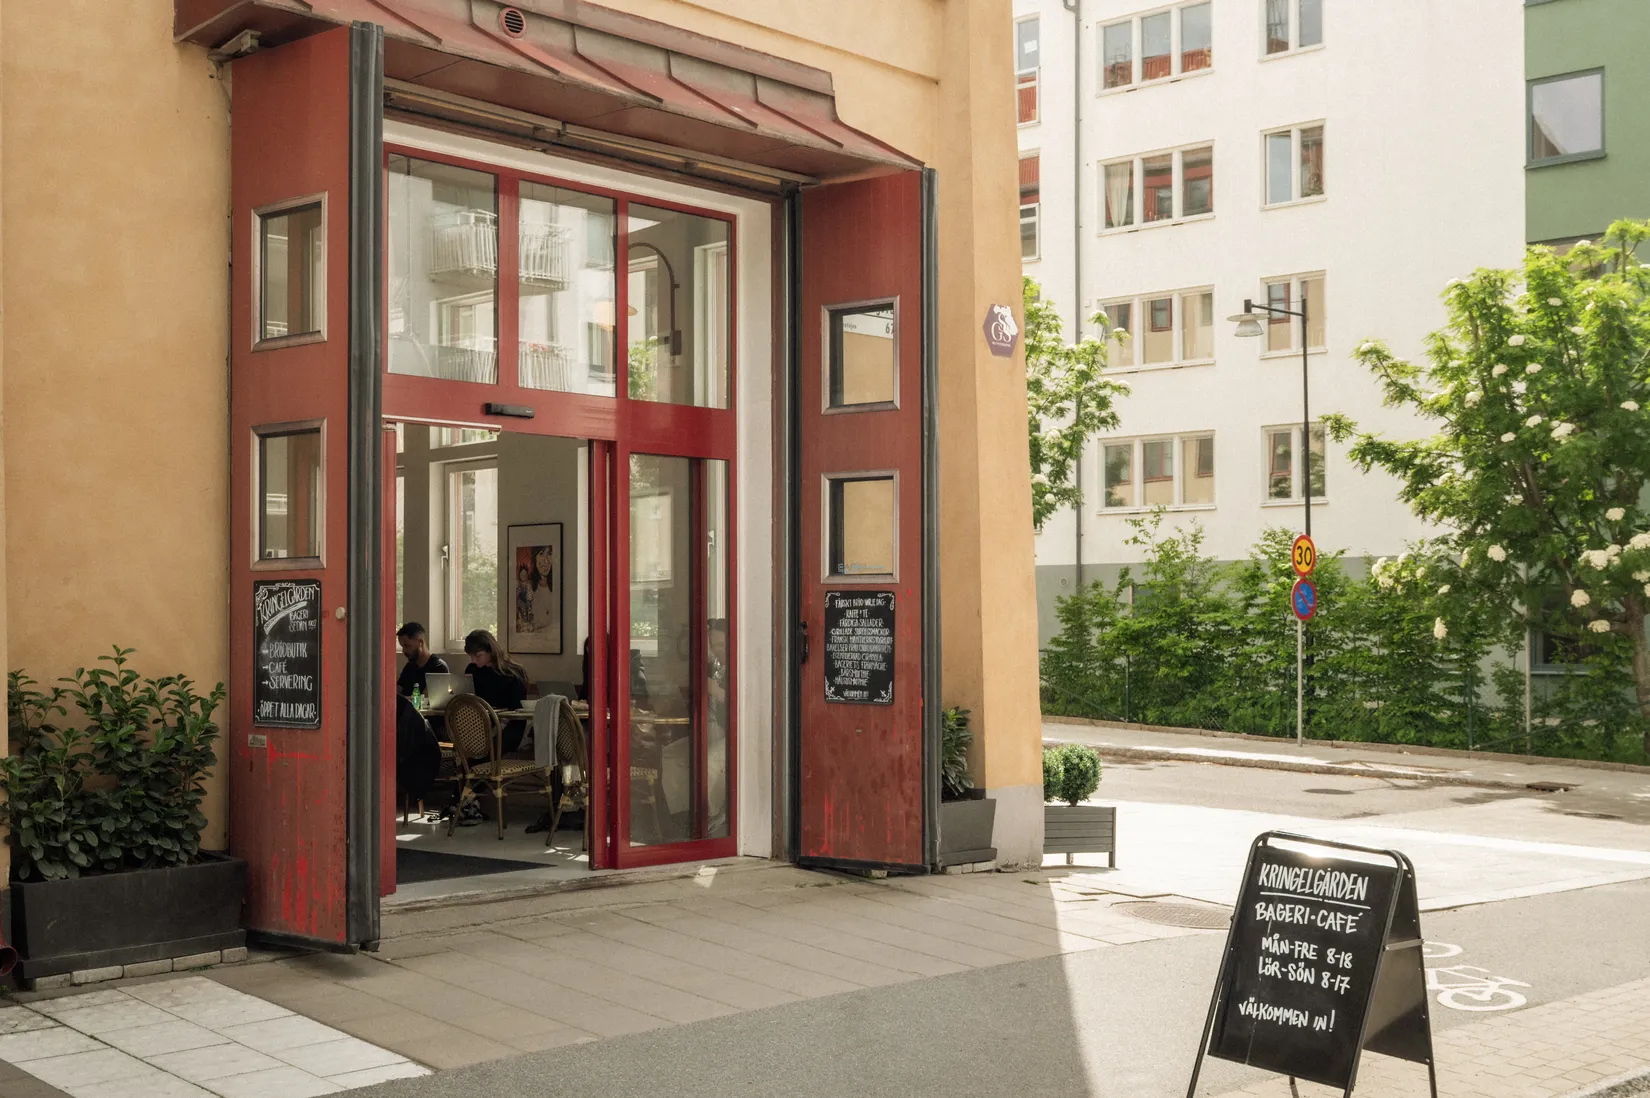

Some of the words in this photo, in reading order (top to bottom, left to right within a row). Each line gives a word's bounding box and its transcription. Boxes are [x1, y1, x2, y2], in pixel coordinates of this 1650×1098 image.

[1296, 545, 1312, 566] 30
[876, 598, 885, 606] DAG
[289, 609, 309, 621] BAGERI
[858, 618, 883, 627] SALLADER
[289, 620, 308, 632] SEDAN
[269, 641, 308, 659] BRÖDBUTIK
[268, 660, 288, 674] CAFÉ
[268, 675, 313, 691] SERVERING
[260, 700, 278, 717] ÖPPET
[280, 703, 295, 719] ALLA
[296, 703, 315, 719] DAGAR
[1258, 862, 1369, 901] KRINGELGÅRDEN
[1261, 933, 1318, 960] MÅN-FRE
[1326, 947, 1353, 970] 8-18
[1258, 956, 1316, 984] LÖR-SÖN
[1320, 971, 1351, 995] 8-17
[1238, 997, 1309, 1027] VÄLKOMMEN
[1313, 1009, 1336, 1033] IN!
